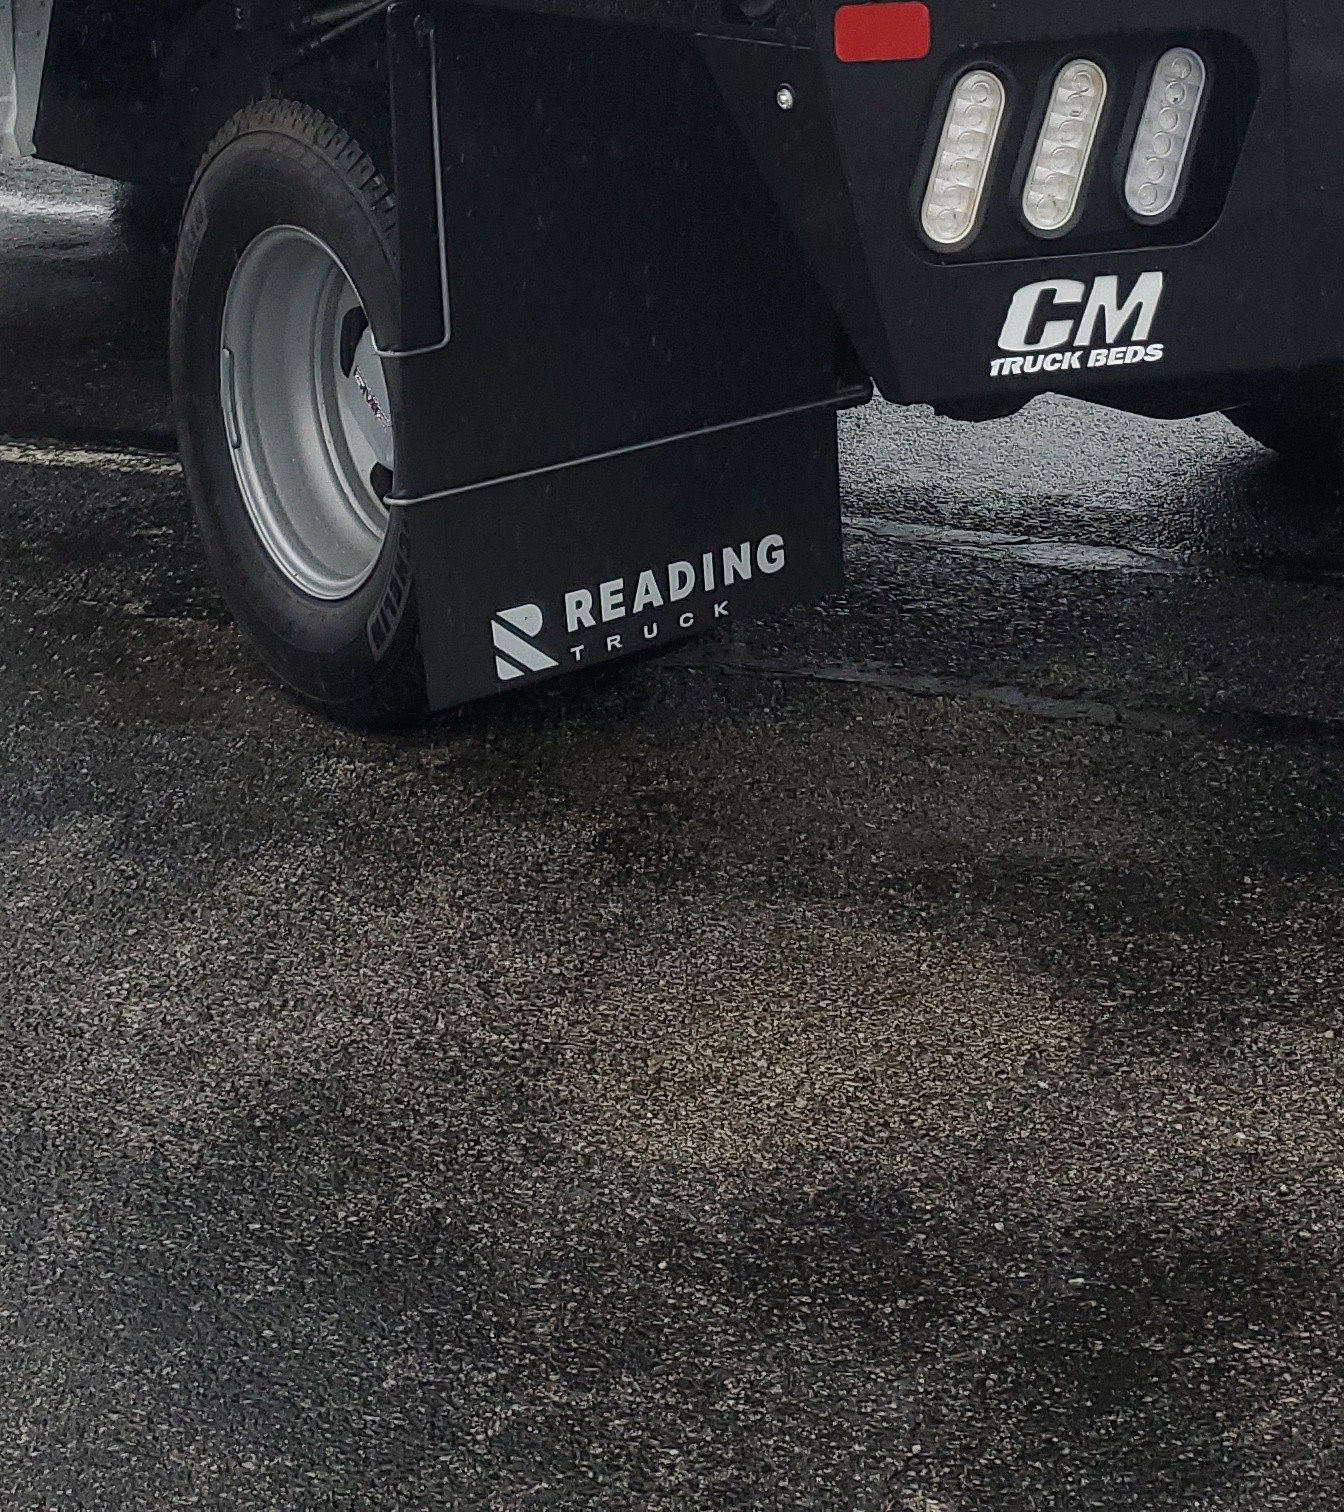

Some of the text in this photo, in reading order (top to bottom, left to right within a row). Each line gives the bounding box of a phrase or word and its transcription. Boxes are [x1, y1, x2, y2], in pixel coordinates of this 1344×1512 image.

[997, 271, 1163, 352] CM
[989, 343, 1165, 377] TRUCK BEDS
[564, 533, 786, 633] READING
[569, 600, 730, 662] TRUCK
